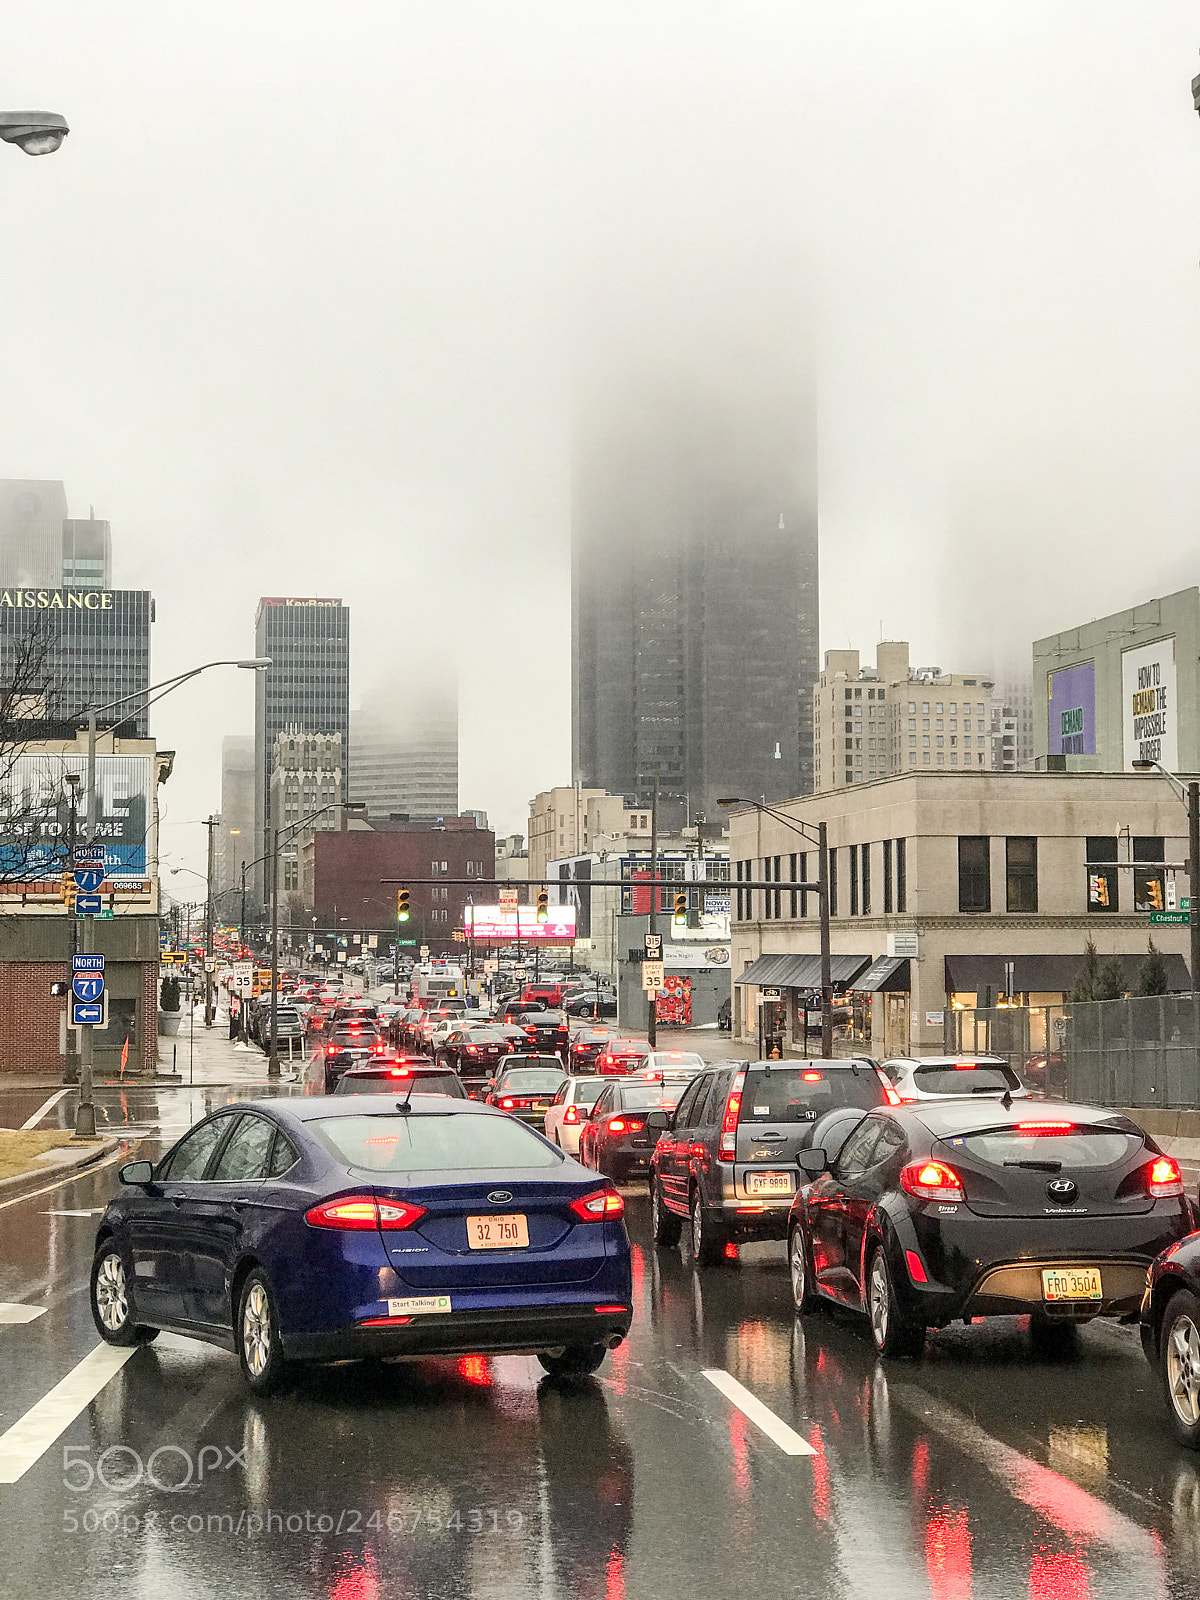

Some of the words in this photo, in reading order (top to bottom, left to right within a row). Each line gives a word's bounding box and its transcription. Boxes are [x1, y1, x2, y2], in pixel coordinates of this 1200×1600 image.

[1137, 664, 1152, 690] HOW
[1152, 662, 1161, 686] TO
[1132, 689, 1156, 717] DEMAND
[1155, 686, 1167, 710] THE
[1061, 708, 1083, 735] DEMAND
[1133, 712, 1167, 740] IMPOSSIBLE
[39, 822, 63, 837] TO
[75, 847, 104, 857] NORTH
[80, 871, 97, 885] 71
[113, 882, 142, 890] 069685
[705, 900, 723, 908] NOW
[1155, 914, 1183, 922] Chestnut
[646, 937, 660, 946] 315
[75, 957, 102, 968] NORTH
[236, 977, 250, 986] 35
[646, 976, 661, 986] 35
[78, 981, 97, 996] 71
[753, 1178, 768, 1189] GXF
[769, 1178, 788, 1189] 9899
[477, 1224, 491, 1241] 32
[497, 1222, 518, 1240] 750
[1047, 1278, 1068, 1294] FRD
[1071, 1276, 1098, 1292] 3504
[411, 1299, 437, 1307] Talking!
